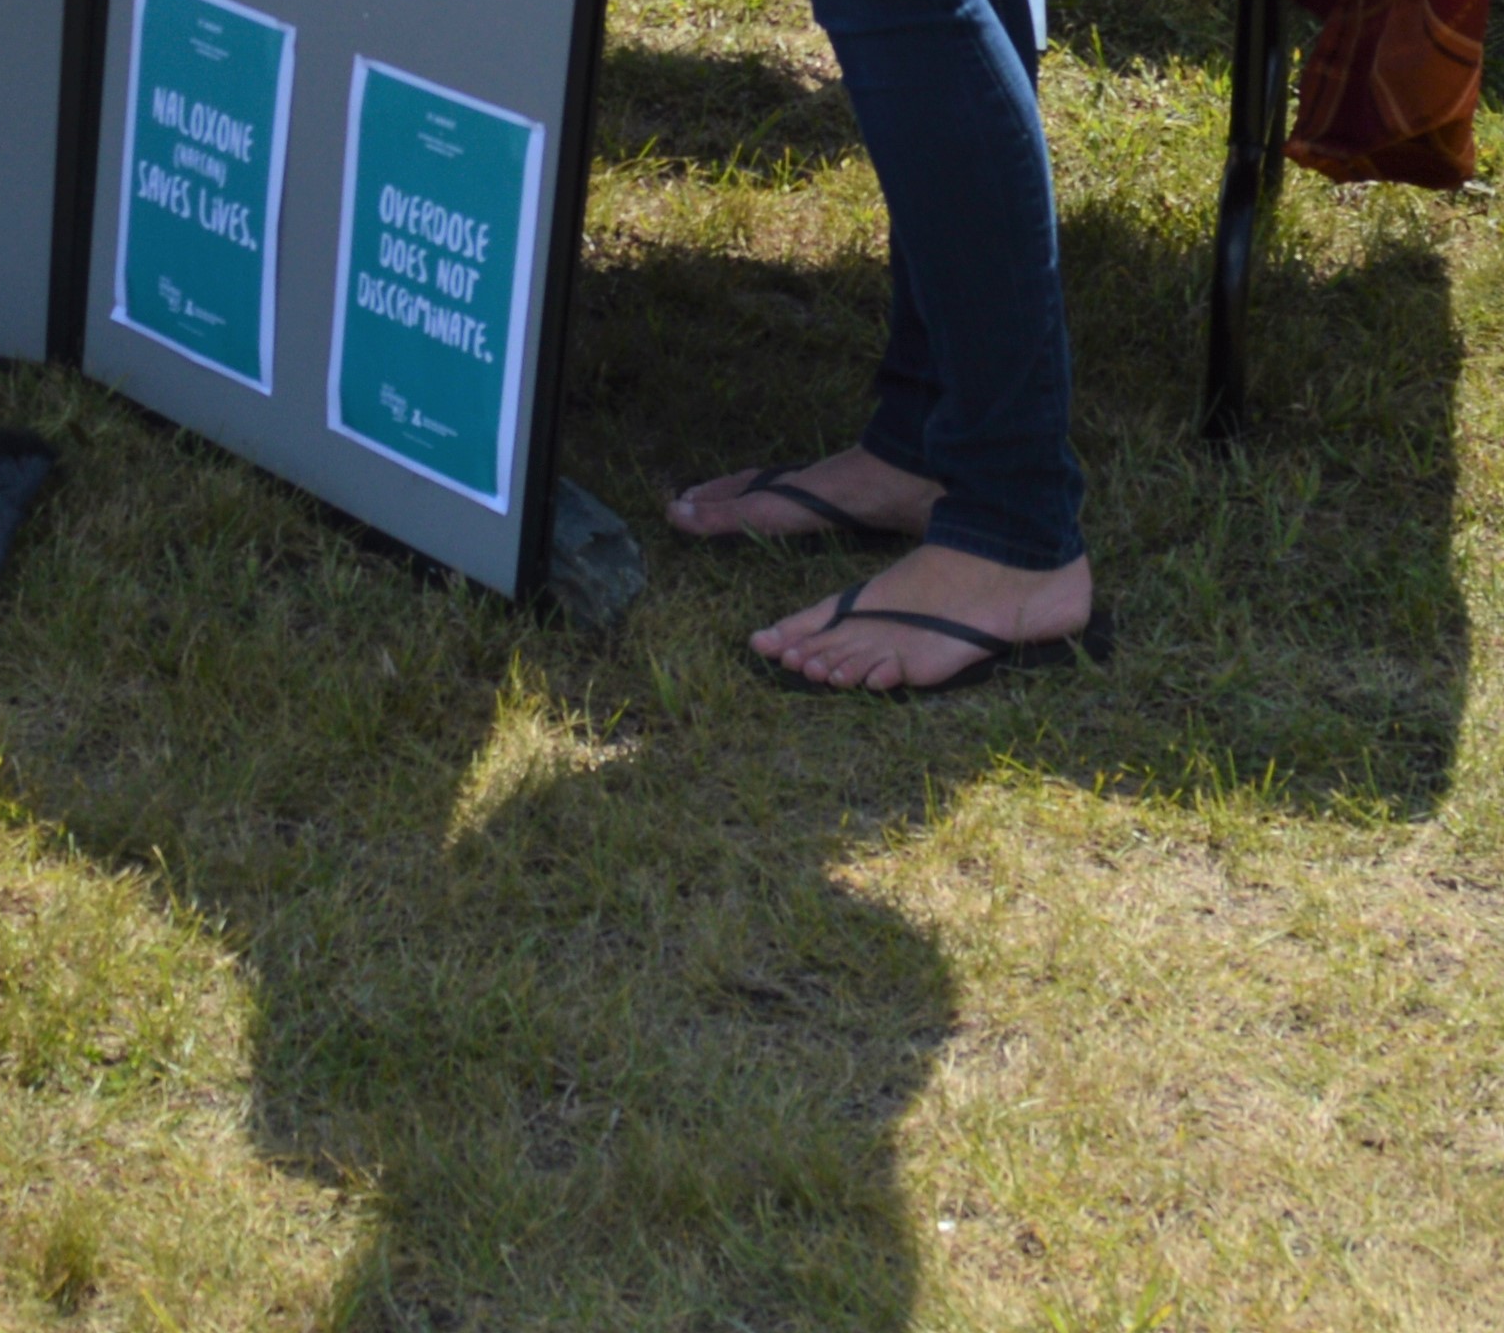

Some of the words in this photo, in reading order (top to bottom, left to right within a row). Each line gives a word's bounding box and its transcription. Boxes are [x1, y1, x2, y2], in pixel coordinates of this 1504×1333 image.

[153, 86, 254, 164] NALOXONE
[138, 160, 191, 219] SAVES
[379, 185, 490, 264] OVERDOSE
[379, 232, 428, 284] DOES
[437, 257, 480, 304] NOT
